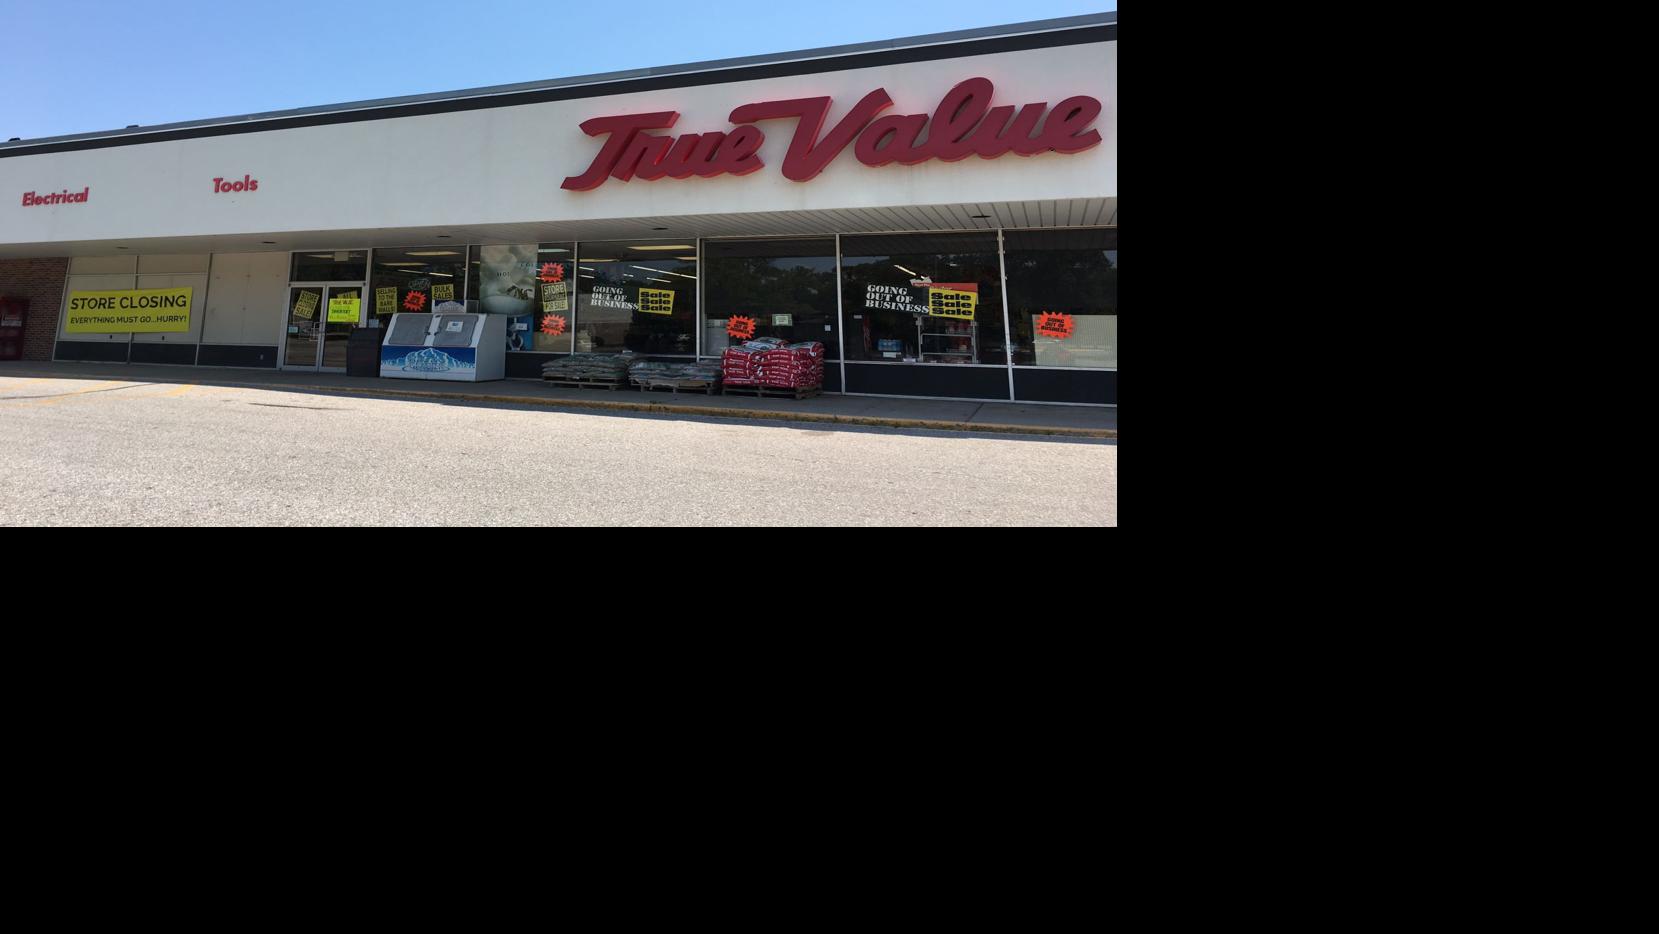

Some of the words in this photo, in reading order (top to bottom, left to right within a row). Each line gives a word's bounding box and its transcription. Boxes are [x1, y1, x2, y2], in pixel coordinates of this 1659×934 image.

[560, 110, 765, 192] True
[729, 76, 1103, 182] Value
[213, 175, 258, 193] Tools
[22, 187, 89, 207] Electrical
[543, 284, 564, 295] STORE
[592, 285, 624, 295] GOING
[640, 291, 671, 299] Sale
[867, 284, 908, 296] GOING
[300, 291, 319, 302] STORE
[433, 292, 452, 300] SALES
[591, 293, 612, 301] OUT
[614, 294, 628, 302] OF
[866, 292, 893, 302] OUT
[895, 294, 914, 304] OF
[931, 292, 972, 301] Sale
[70, 297, 116, 310] STORE
[119, 295, 187, 309] CLOSING
[590, 299, 640, 312] BUSINESS
[865, 299, 929, 314] BUSINESS
[931, 299, 972, 309] Sale
[932, 307, 973, 316] Sale
[70, 316, 115, 324] EVERYTHING
[1040, 325, 1068, 333] BUSINESS
